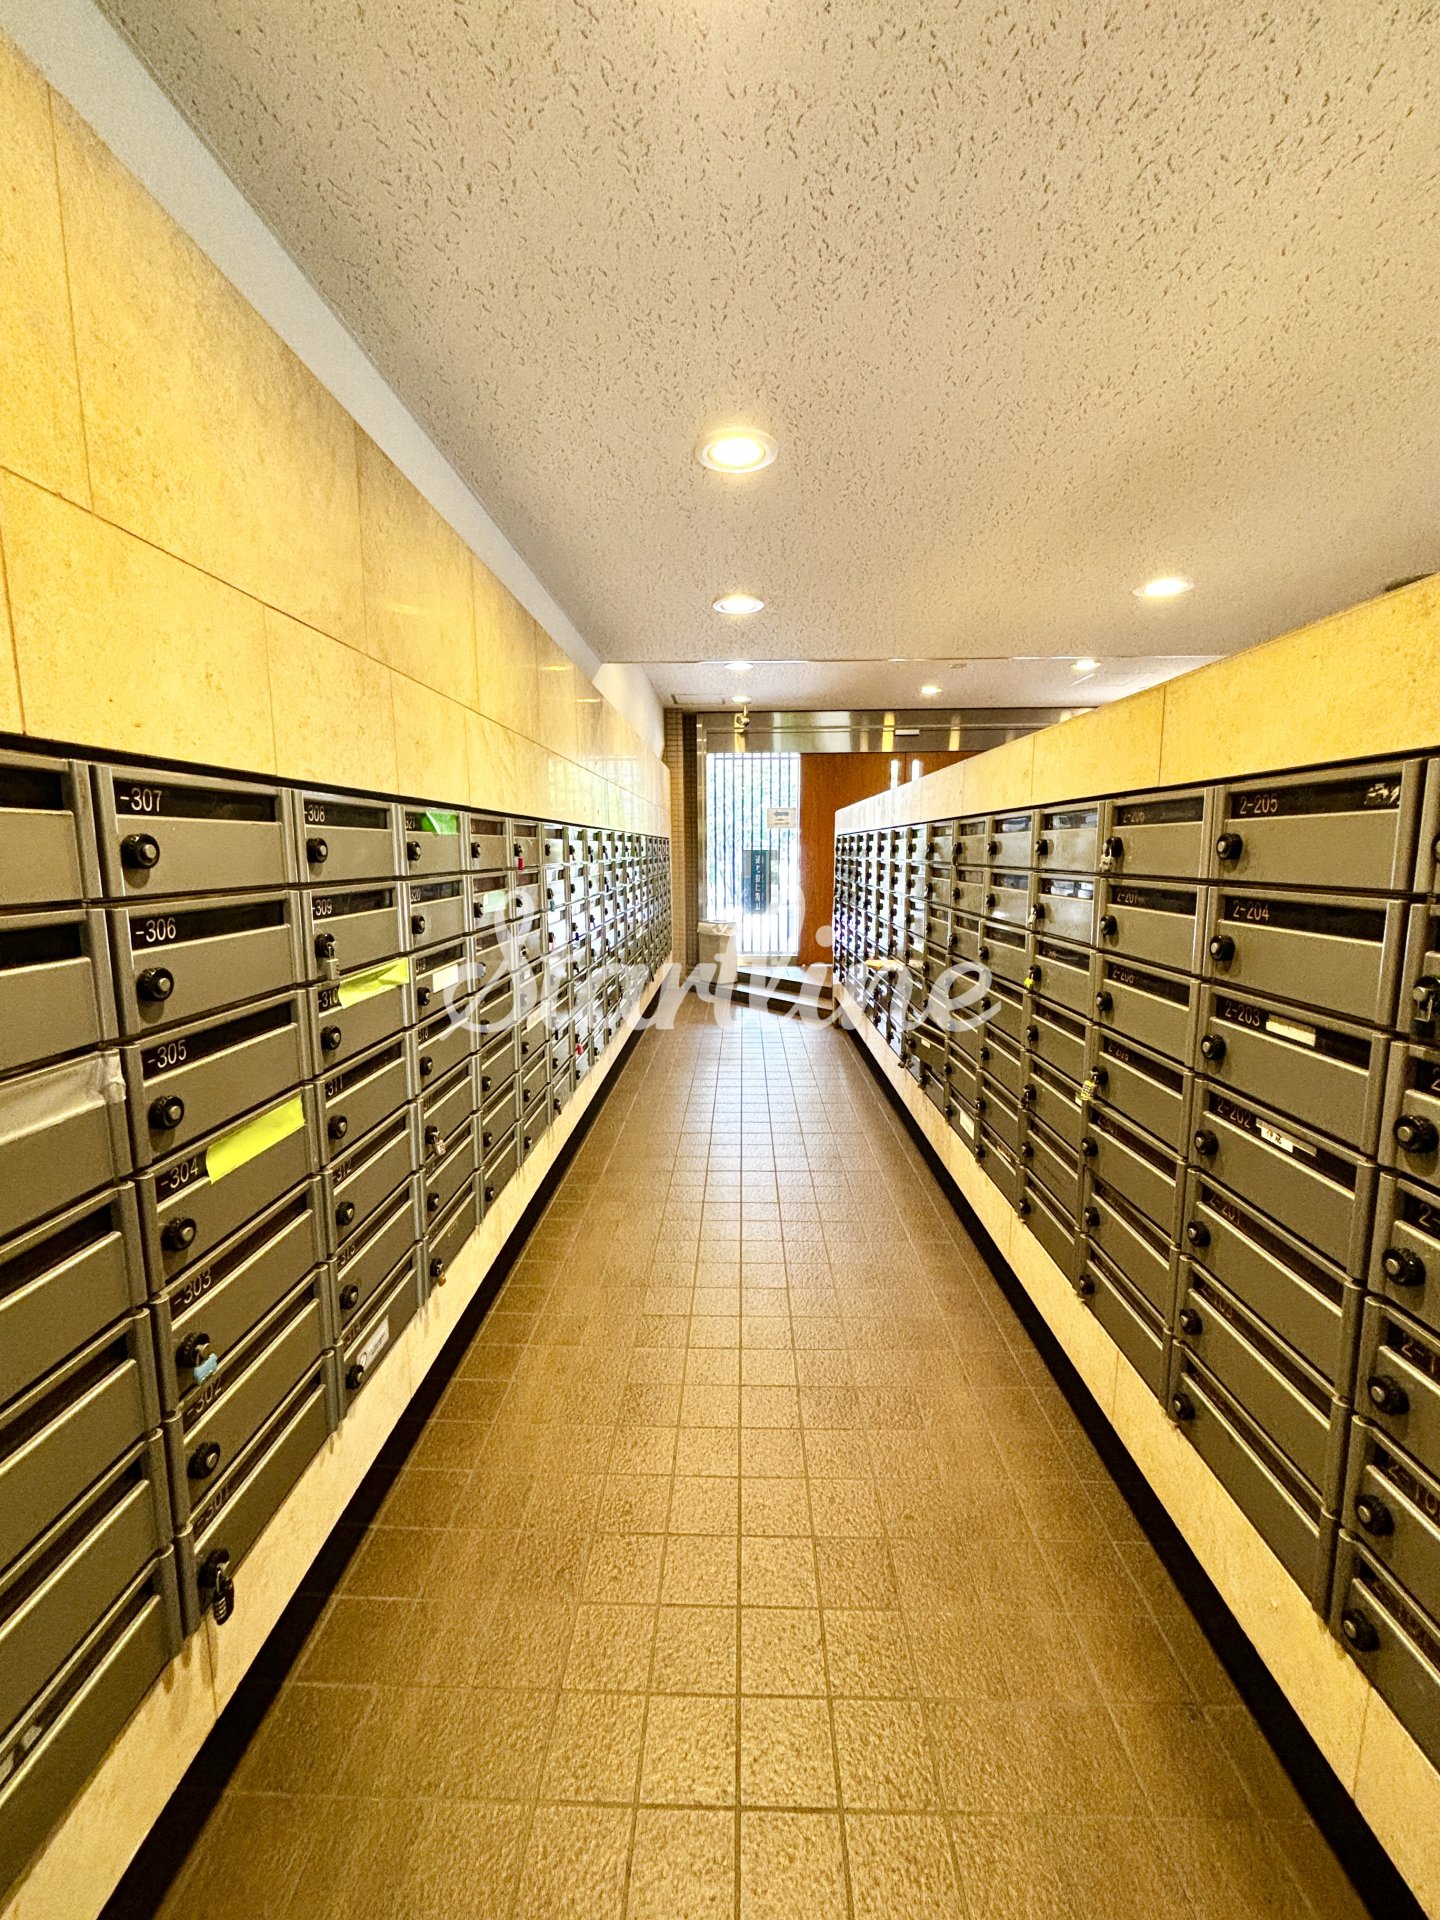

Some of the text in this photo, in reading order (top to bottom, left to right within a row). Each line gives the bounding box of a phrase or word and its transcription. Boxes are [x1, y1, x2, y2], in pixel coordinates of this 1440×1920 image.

[120, 787, 162, 812] -307
[1239, 793, 1278, 815] 2-205
[1232, 900, 1270, 921] 2-204
[135, 917, 176, 942] -306
[1224, 1001, 1260, 1027] 2-203
[147, 1039, 186, 1068] -305
[1216, 1096, 1251, 1129] 2-202
[161, 1158, 198, 1189] -304
[174, 1267, 211, 1305] -303
[187, 1376, 222, 1416] -302
